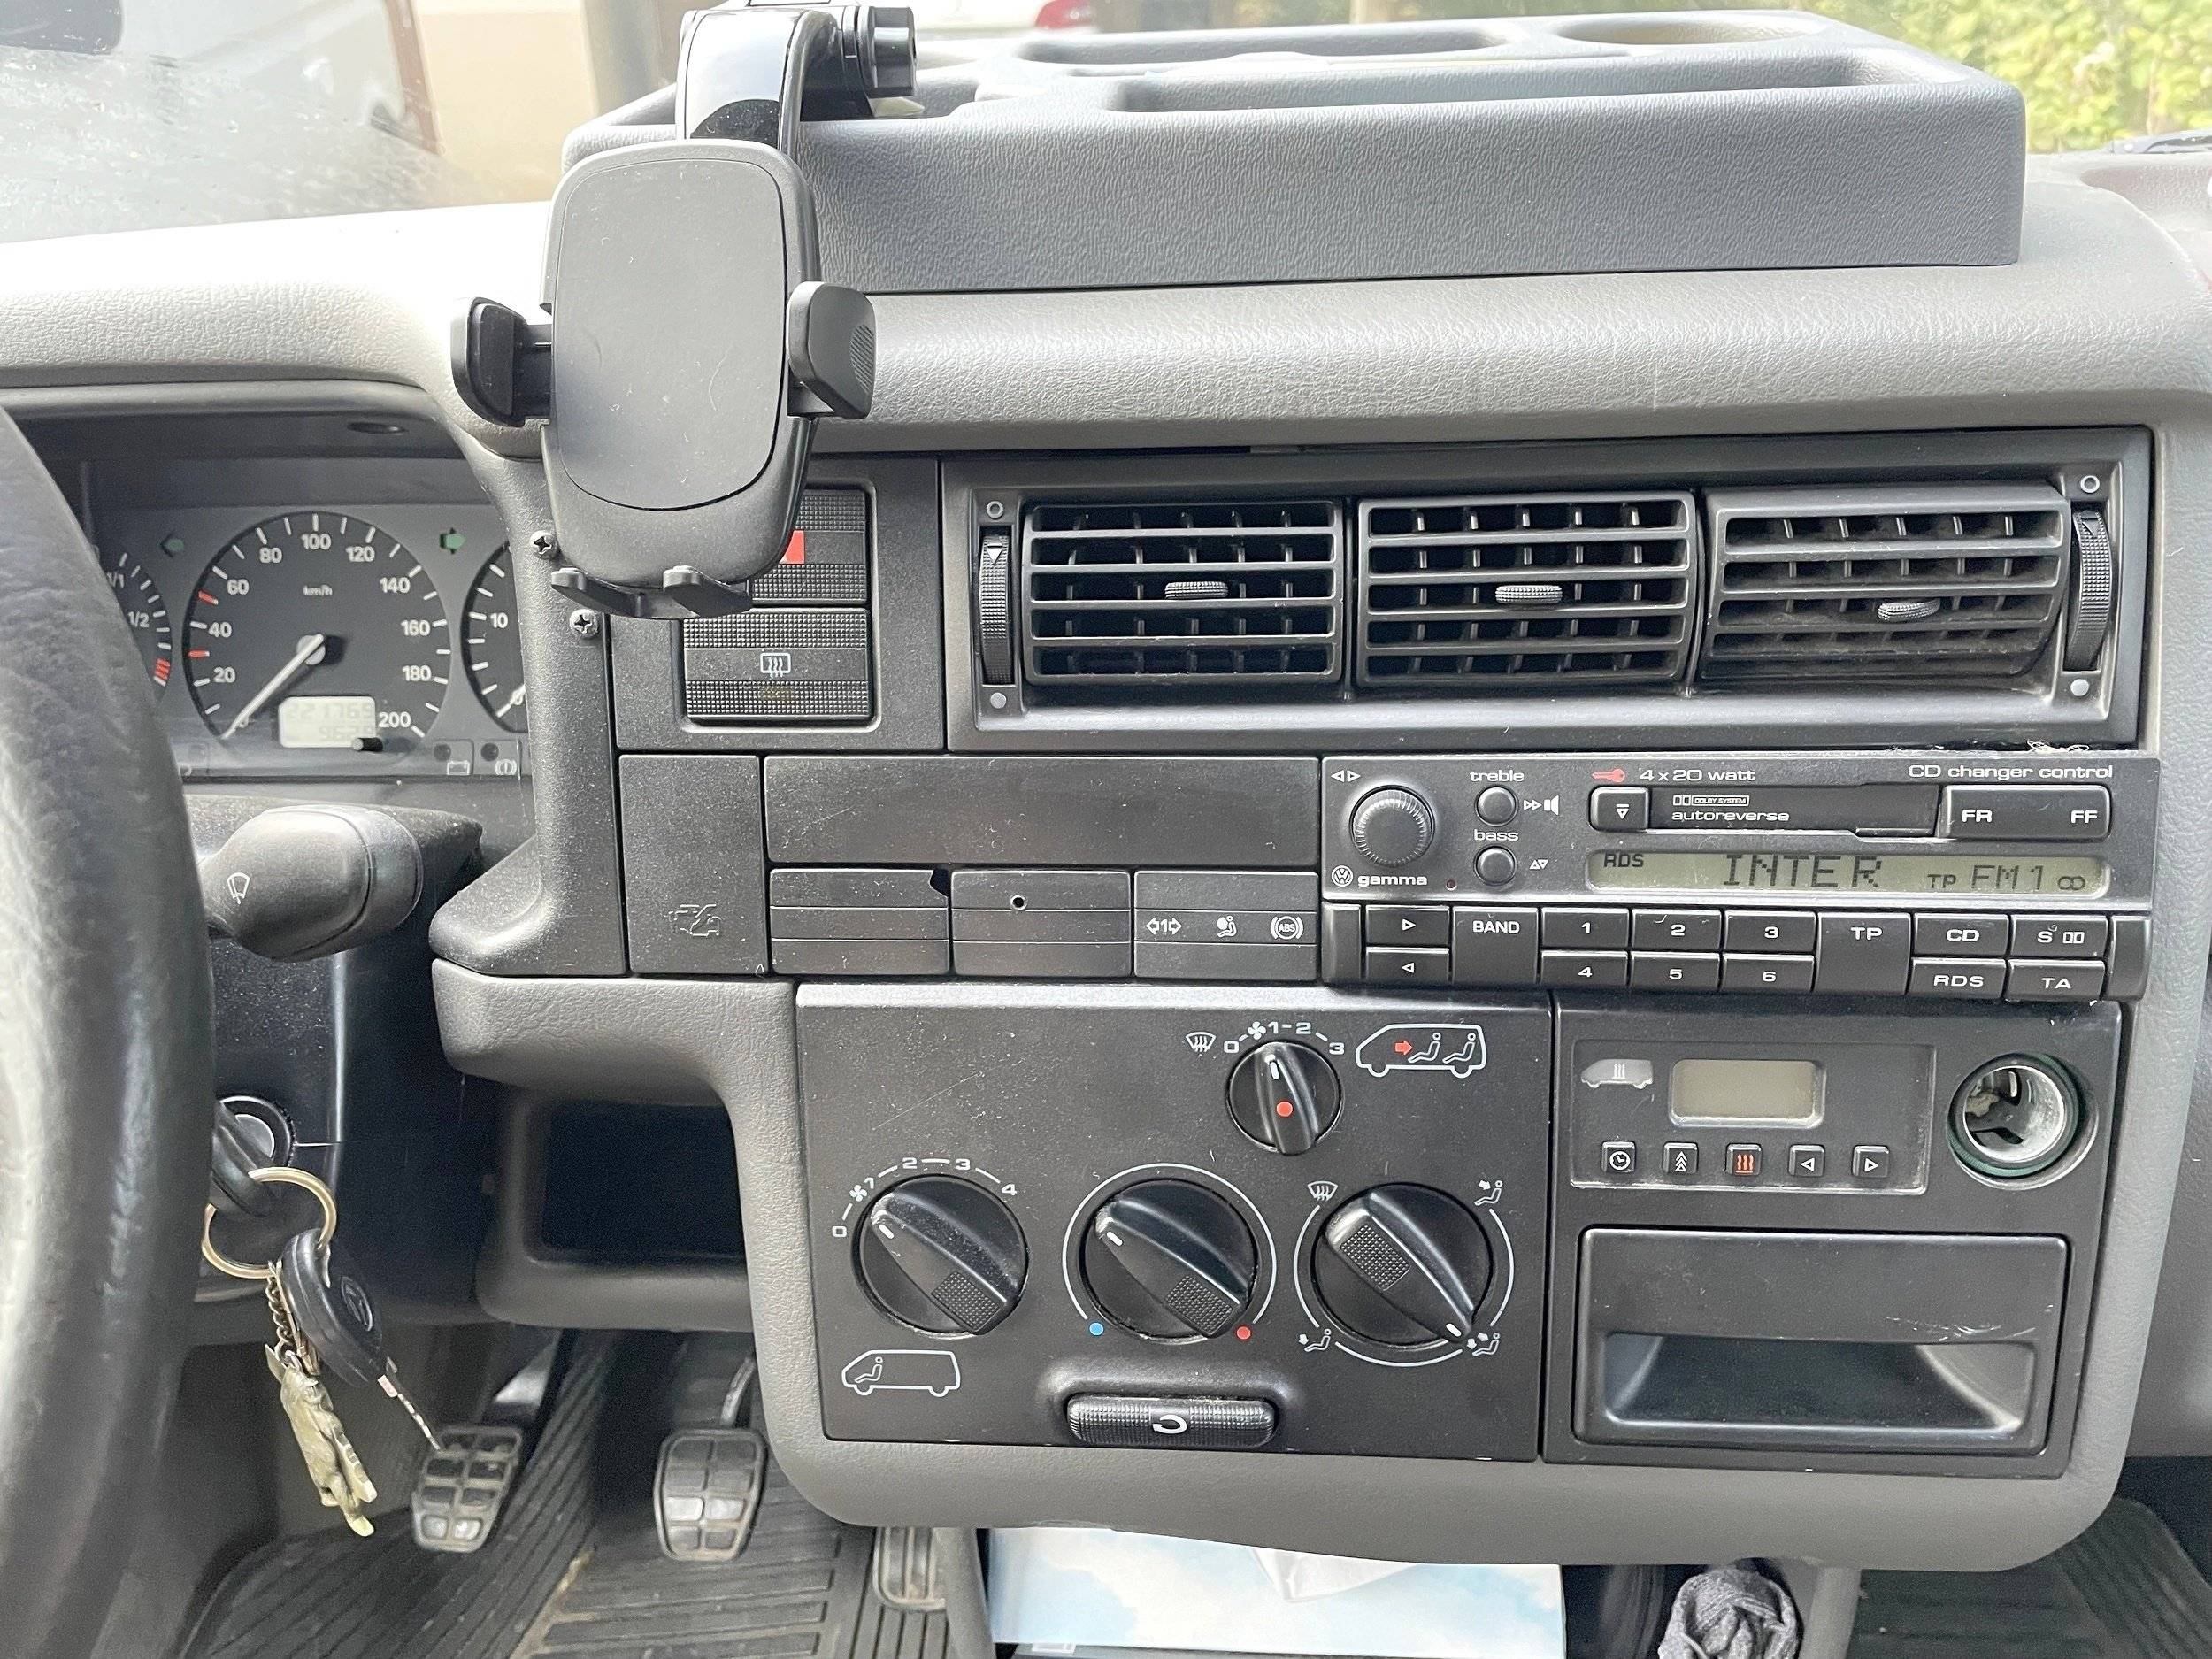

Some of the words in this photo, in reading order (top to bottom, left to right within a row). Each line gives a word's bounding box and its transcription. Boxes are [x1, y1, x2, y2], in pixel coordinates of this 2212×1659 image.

[302, 534, 332, 549] 100
[259, 547, 283, 564] 80
[346, 546, 375, 562] 120
[227, 579, 250, 595] 60
[303, 585, 333, 595] km/h
[380, 577, 411, 594] 140
[127, 611, 150, 627] 1/2
[490, 612, 509, 628] 10
[208, 622, 232, 638] 40
[401, 619, 431, 636] 160
[213, 666, 236, 683] 20
[403, 664, 432, 681] 180
[378, 711, 411, 728] 200
[1470, 770, 1525, 782] treble
[1640, 770, 1655, 781] 4
[1657, 772, 1670, 782] x
[1672, 770, 1703, 781] 20
[1707, 770, 1756, 782] watt
[1909, 765, 1941, 778] CD
[1947, 765, 2034, 780] changer
[2039, 765, 2113, 779] control
[1671, 810, 1790, 821] autoreverse
[1962, 809, 1993, 823] FR
[2070, 810, 2098, 824] FF
[1474, 829, 1519, 841] bass
[1603, 854, 1644, 868] RDS
[1724, 854, 1882, 887] INTER
[1927, 874, 1956, 888] TP
[1357, 875, 1428, 887] gamma
[1278, 923, 1296, 933] ABS
[1472, 920, 1520, 933] BAND
[1581, 923, 1592, 934] 1
[1671, 925, 1686, 936] 2
[1764, 926, 1779, 939] 3
[1851, 927, 1883, 940] TP
[1947, 929, 1980, 942] CD
[1578, 966, 1593, 978] 4
[1670, 968, 1683, 979] 5
[1762, 971, 1777, 982] 6
[1933, 974, 1985, 987] RDS
[2041, 977, 2071, 989] TA
[1268, 1021, 1279, 1034] 1
[1295, 1022, 1311, 1034] 2
[1224, 1041, 1240, 1053] 0
[1329, 1042, 1345, 1055] 3
[902, 1157, 918, 1169] 2
[956, 1158, 971, 1170] 3
[864, 1177, 874, 1189] 1
[1002, 1184, 1017, 1196] 4
[832, 1225, 848, 1237] 0
